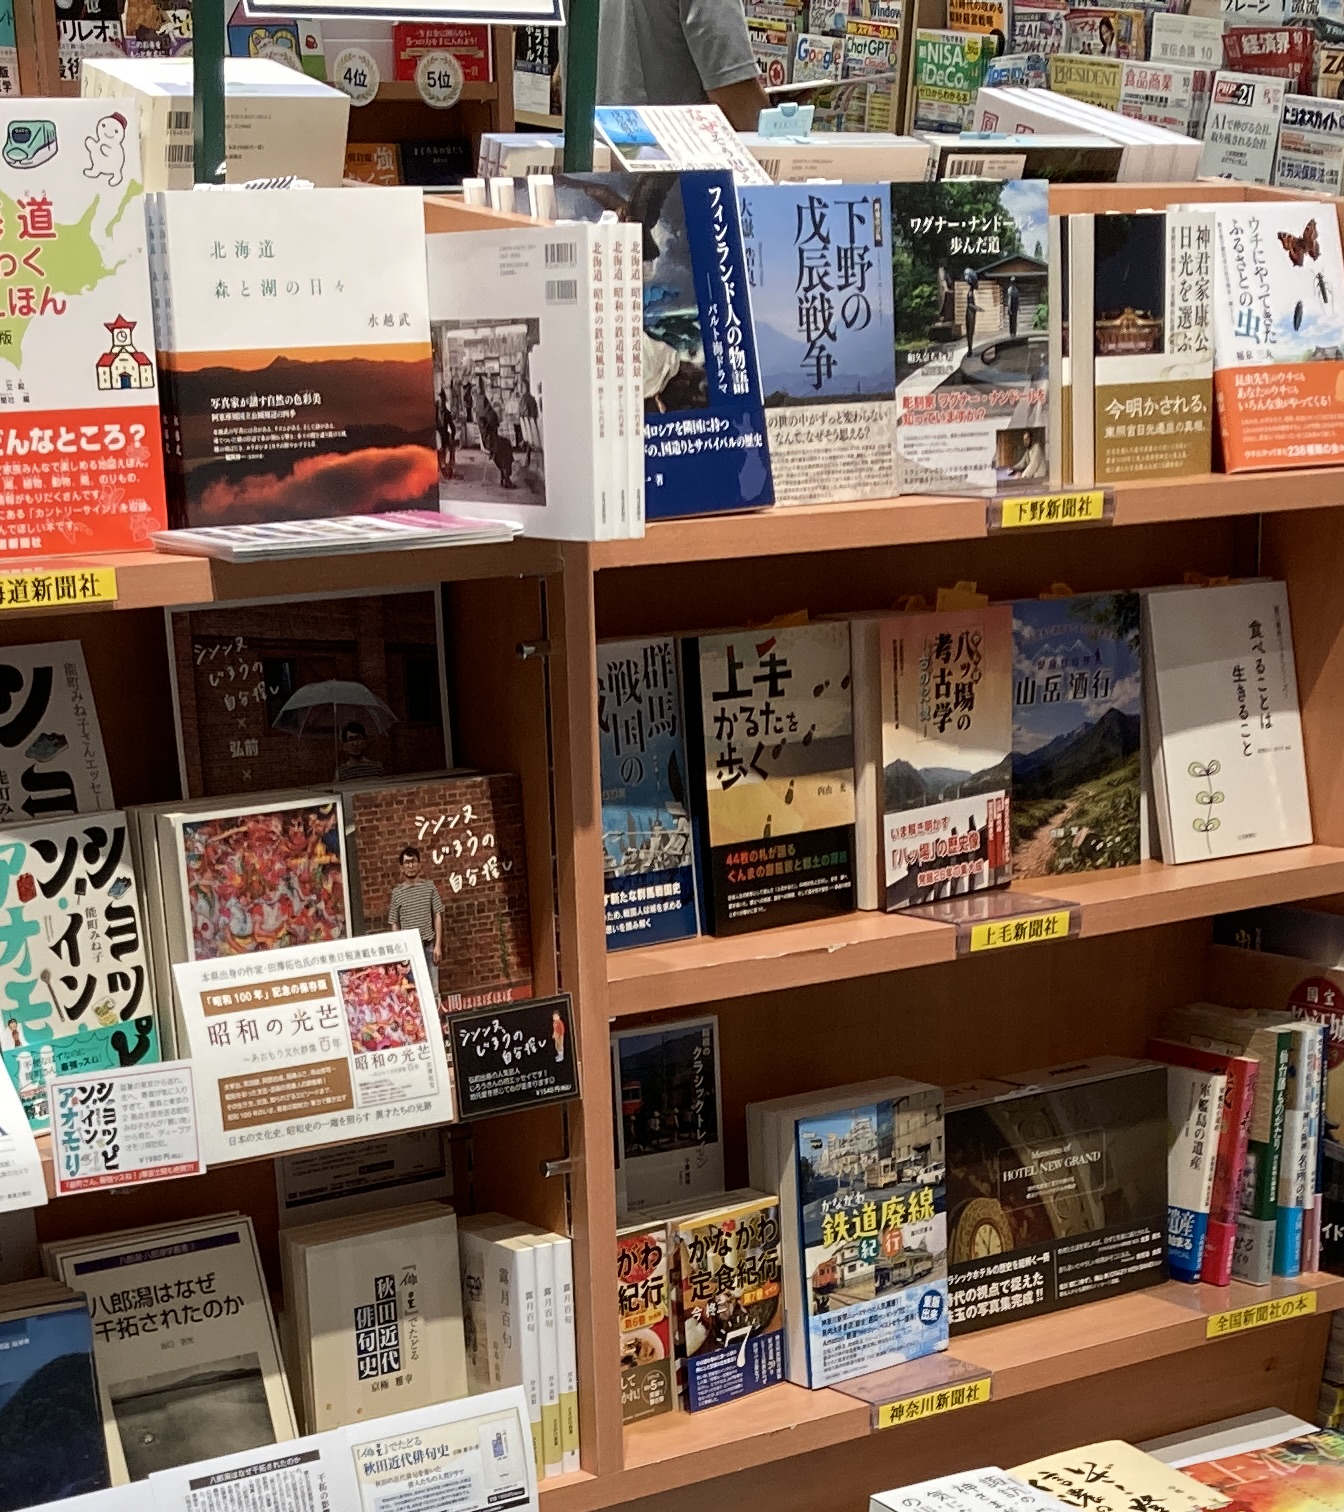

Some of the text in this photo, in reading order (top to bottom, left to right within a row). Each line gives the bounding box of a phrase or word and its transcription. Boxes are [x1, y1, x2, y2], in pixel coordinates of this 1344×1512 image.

[797, 40, 843, 68] Google
[846, 35, 890, 58] ChatGPT
[927, 42, 962, 65] NISA
[1242, 32, 1291, 54] 経済界
[343, 66, 368, 88] 4位
[427, 69, 453, 89] 5位
[1053, 63, 1118, 87] PRESIDENT
[1123, 70, 1174, 92] 食品商業
[210, 240, 275, 259] 北海道
[835, 198, 875, 332] 下野の
[949, 236, 1001, 255] 歩んだ道
[213, 279, 348, 299] 森と湖の日々
[708, 186, 750, 394] フィンランド人の物語
[794, 195, 838, 391] 戊辰戦争
[1177, 224, 1192, 354] 日光を選ぶ
[1194, 224, 1212, 352] 神君家康公
[1229, 219, 1262, 345] ふるさとの虫
[1248, 216, 1278, 346] ウチにやってきた
[367, 313, 410, 328] 水越武
[1105, 396, 1208, 419] 今明かされる、
[1016, 496, 1092, 521] 下野新聞社
[712, 636, 792, 702] 上毛
[932, 634, 953, 734] 考古学
[953, 630, 976, 731] 八ッ場の
[1016, 669, 1115, 706] 山岳酒行
[1247, 619, 1274, 731] 食べることは
[642, 643, 676, 738] 群馬
[1232, 665, 1253, 758] 生きること
[607, 659, 645, 787] 戦国の
[714, 702, 798, 741] かるたを
[716, 742, 768, 790] 歩く
[413, 806, 478, 841] シソンヌ
[432, 832, 495, 866] じろうの
[449, 861, 513, 894] 自分探し
[84, 907, 103, 964] 能町みね子
[982, 917, 1061, 949] 上毛新聞社
[208, 1005, 341, 1047] 昭和の光芒
[356, 1044, 431, 1071] 昭和の光芒
[58, 1088, 80, 1178] アオモリ
[1002, 1150, 1101, 1184] HOTEL NEW GRAND
[688, 1215, 777, 1264] かながわ
[821, 1197, 937, 1250] 鉄道廃線
[90, 1272, 217, 1321] 八郎潟はなぜ
[690, 1249, 781, 1302] 定食紀行
[94, 1295, 244, 1343] 干拓されたのか
[375, 1274, 402, 1372] 秋田近代
[1215, 1296, 1309, 1333] 全国新聞社の本
[355, 1302, 379, 1381] 俳句史
[889, 1383, 982, 1426] 神奈川新聞社
[363, 1446, 451, 1476] 秋田近代俳句史
